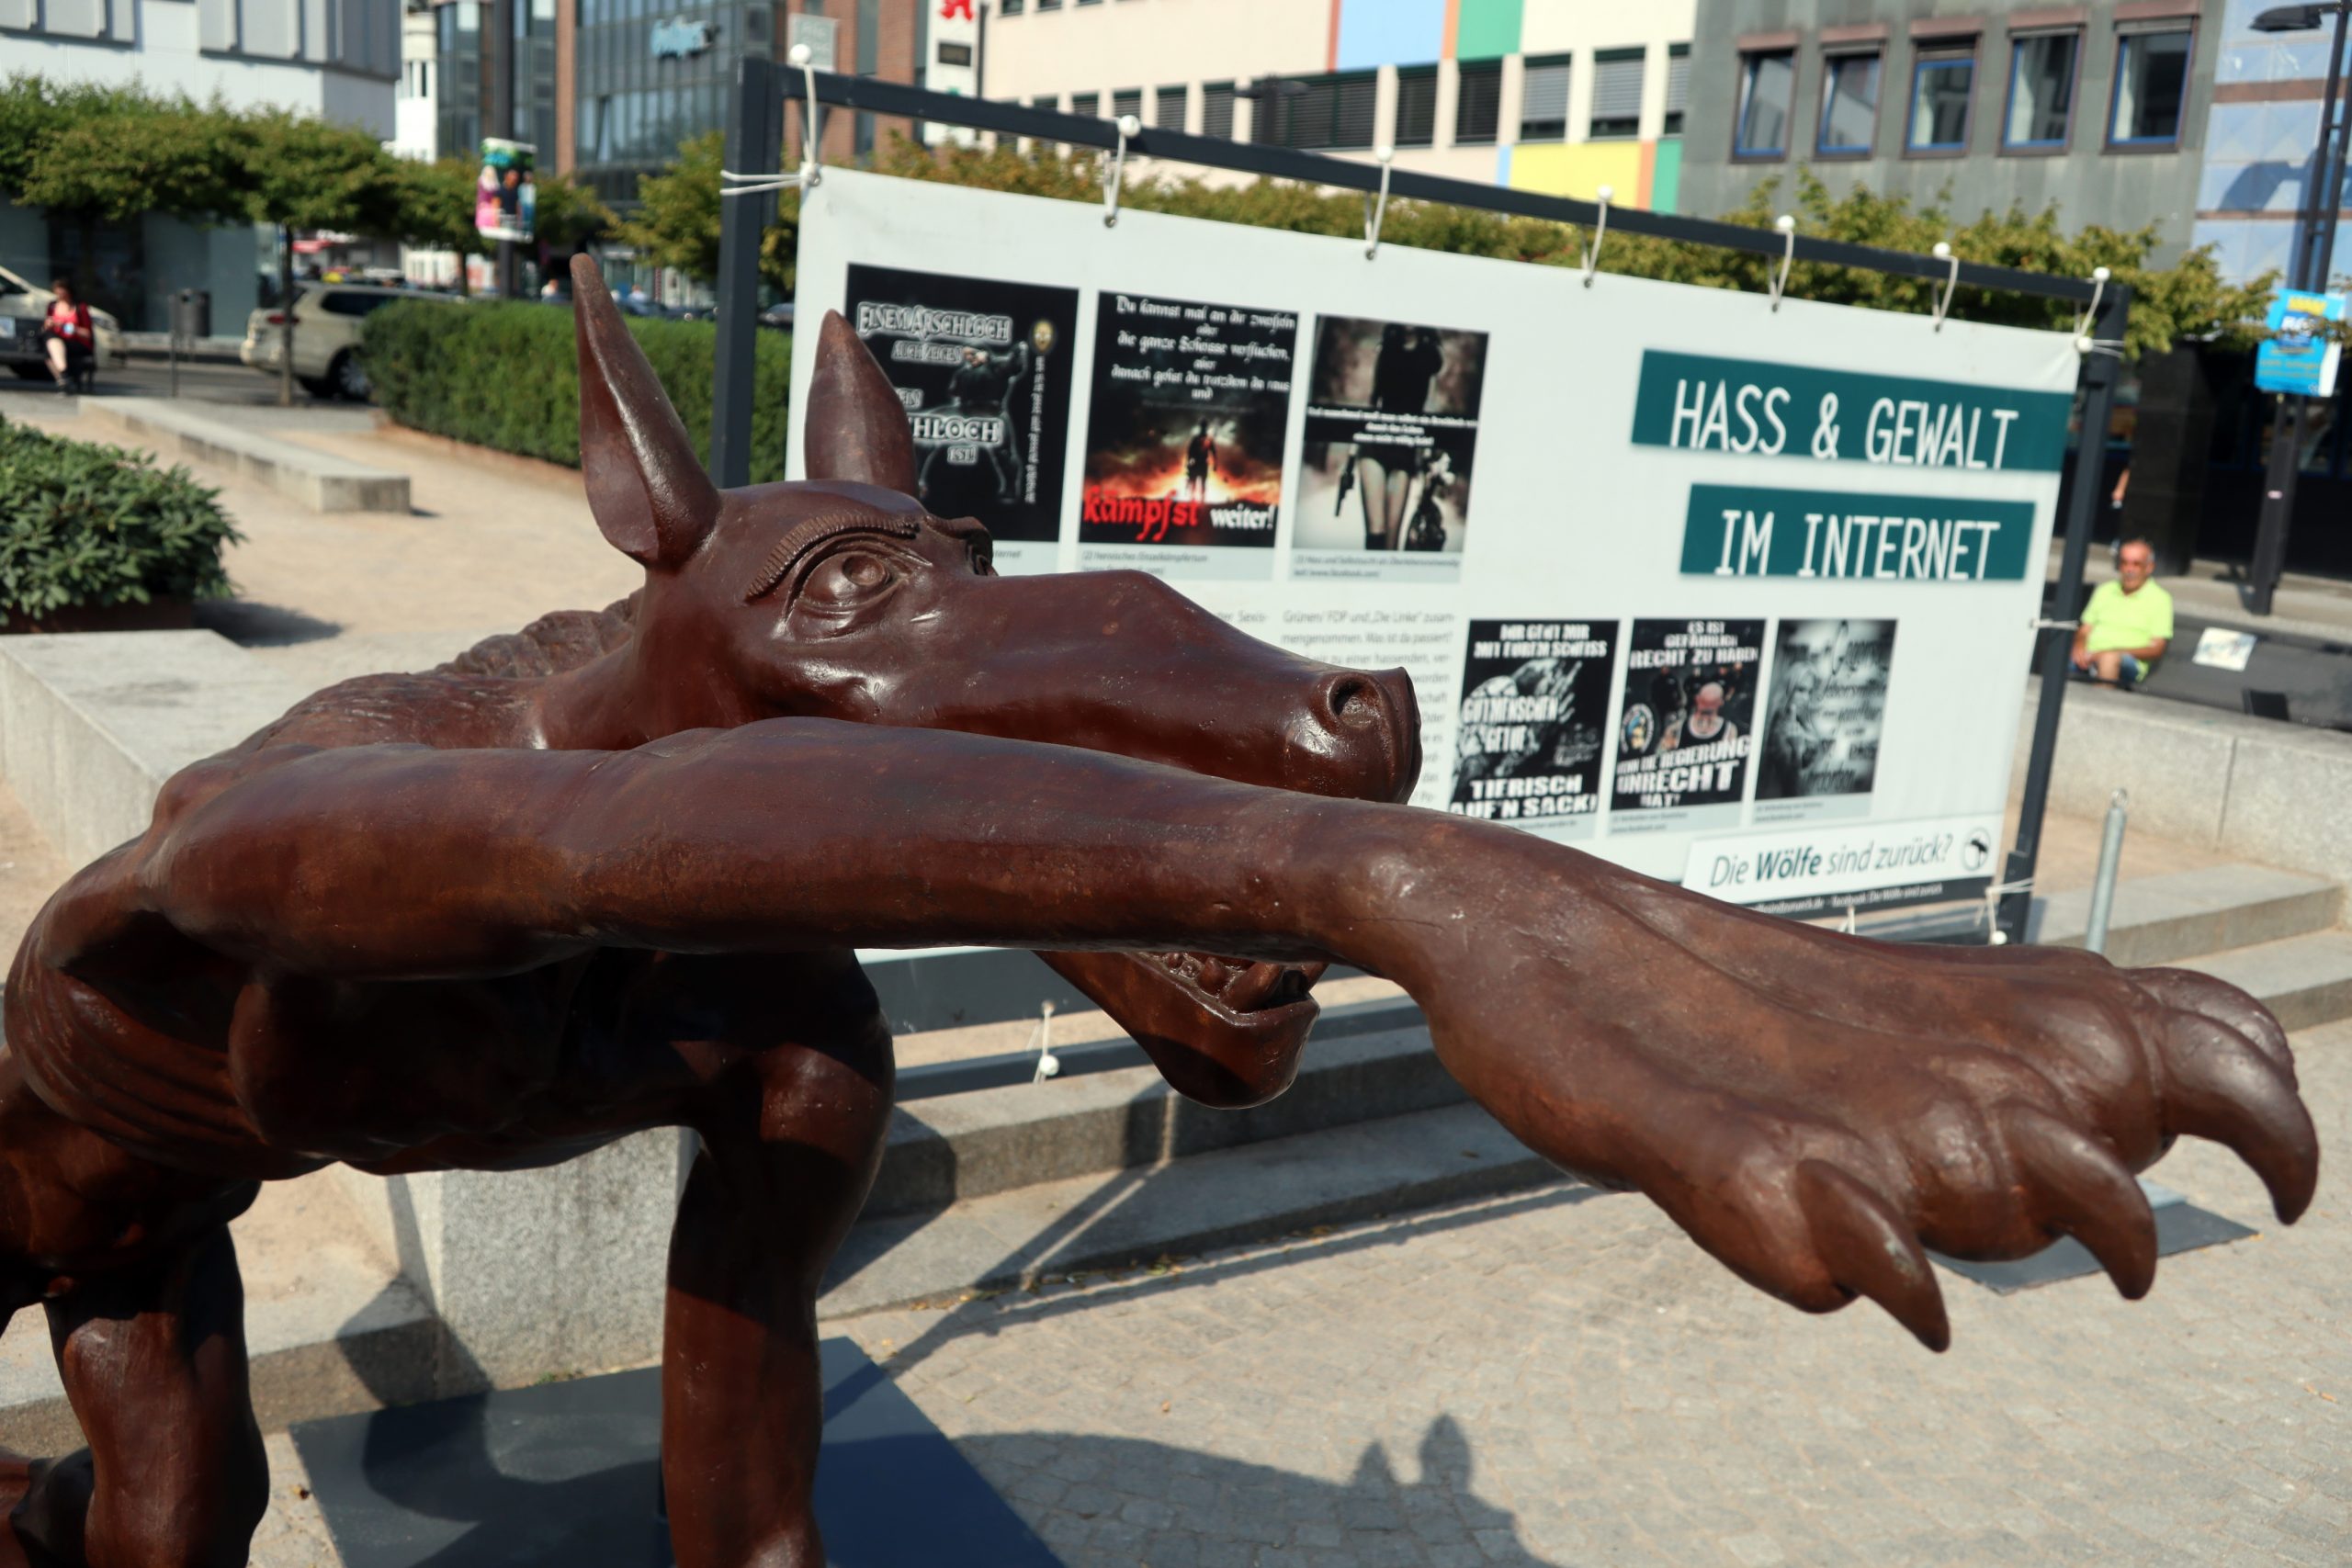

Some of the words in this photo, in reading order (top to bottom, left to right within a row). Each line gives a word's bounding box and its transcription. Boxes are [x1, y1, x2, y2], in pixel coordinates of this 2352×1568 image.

[858, 305, 910, 333] EINEM
[910, 307, 1009, 340] ARSCHLOCH
[1116, 295, 1136, 314] Du
[1139, 299, 1181, 319] kannst
[1184, 305, 1208, 321] mal
[1210, 310, 1227, 322] an
[1229, 309, 1246, 324] dir
[1117, 330, 1136, 346] die
[1139, 335, 1176, 355] ganze
[1111, 363, 1151, 380] danach
[1153, 367, 1183, 388] gehst
[1185, 370, 1200, 385] du
[1203, 373, 1248, 389] trotzdem
[1250, 376, 1265, 390] da
[1192, 386, 1214, 400] und
[909, 416, 998, 442] HLOCH
[1669, 378, 1791, 456] HASS
[1811, 392, 1839, 459] &
[1865, 396, 2019, 470] GEWALT
[1083, 485, 1199, 542] kämpfst
[1210, 502, 1274, 530] weiter!
[1714, 509, 1775, 577] IM
[1796, 513, 2001, 581] INTERNET
[1351, 611, 1368, 623] und
[1706, 620, 1725, 635] IST
[1473, 641, 1500, 659] MIT
[1664, 633, 1739, 649] GEFÄHRLICH
[1629, 648, 1688, 670] RECHT
[1691, 648, 1713, 665] ZU
[1715, 646, 1759, 663] HABEN
[1659, 735, 1752, 768] REGIERUNG
[1469, 773, 1583, 800] TIERISCH
[1616, 759, 1740, 794] UNRECHT
[1521, 793, 1599, 818] SACK!
[1711, 853, 1749, 887] Die
[1756, 845, 1823, 882] Wölfe
[1826, 841, 1875, 875] sind
[1875, 834, 1954, 872] zurück?
